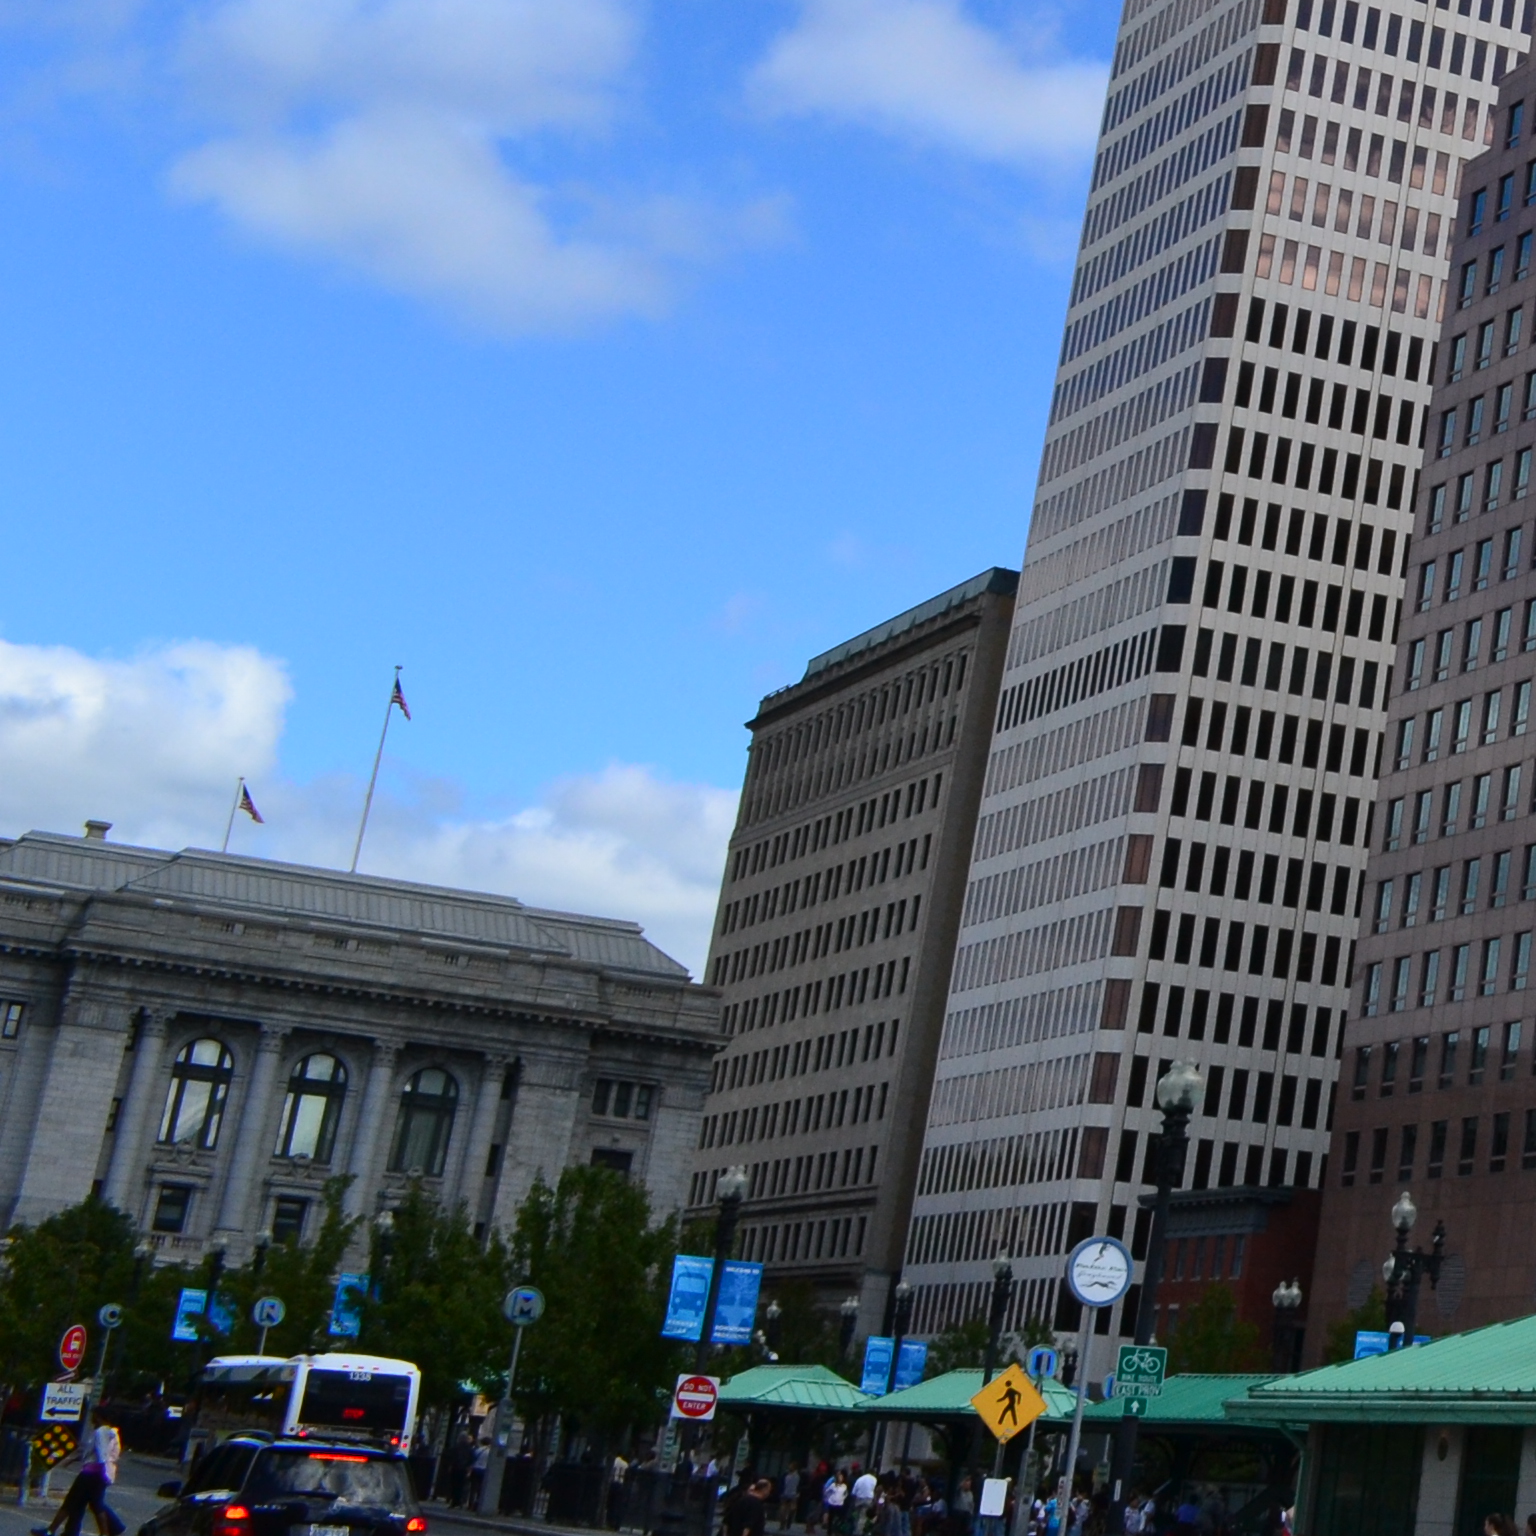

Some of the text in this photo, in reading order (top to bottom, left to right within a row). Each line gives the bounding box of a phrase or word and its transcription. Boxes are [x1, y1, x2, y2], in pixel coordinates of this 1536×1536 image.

[57, 1385, 74, 1393] ALL
[684, 1383, 713, 1392] DO NOT
[47, 1396, 82, 1405] TRAFFIC
[682, 1401, 706, 1410] ENTER
